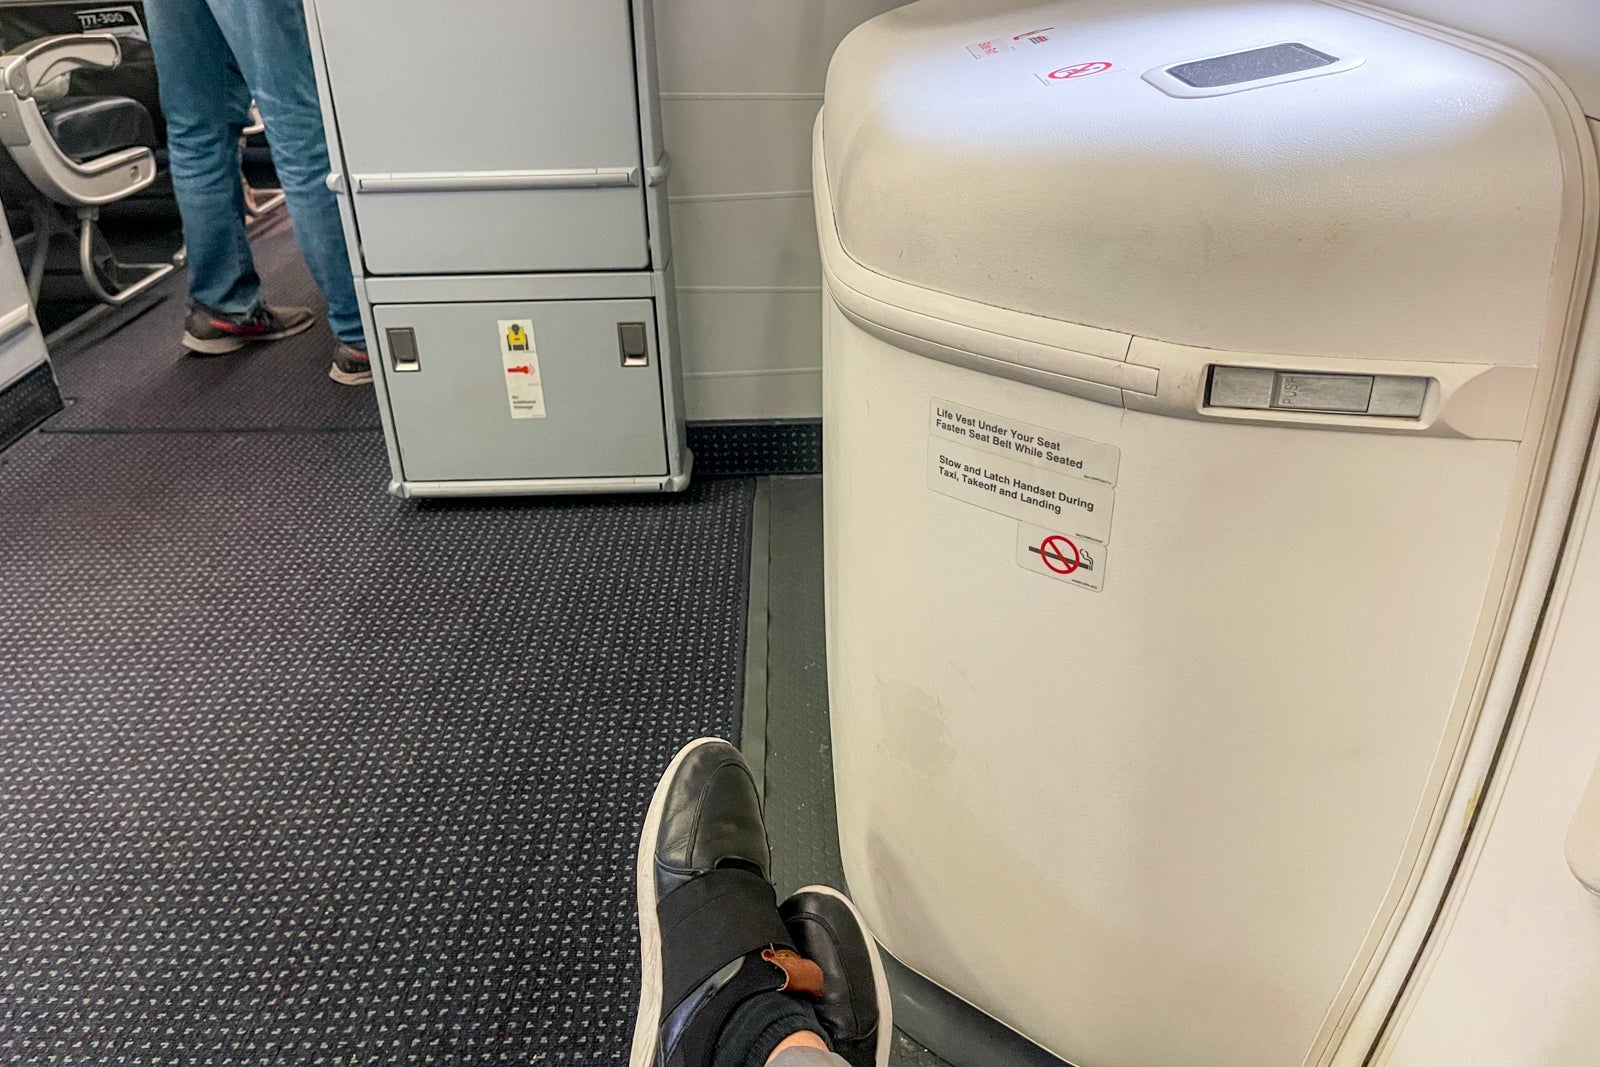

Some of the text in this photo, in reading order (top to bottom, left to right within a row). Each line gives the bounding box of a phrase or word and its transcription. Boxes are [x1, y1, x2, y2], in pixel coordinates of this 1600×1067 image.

[936, 407, 1061, 452] Life Vest Under Your Seat
[936, 418, 1083, 469] Fasten Seat Belt While Seated
[938, 465, 1062, 515] Taxi, Takeoff and Landing
[939, 454, 1095, 513] Stow and Latch Handset During
